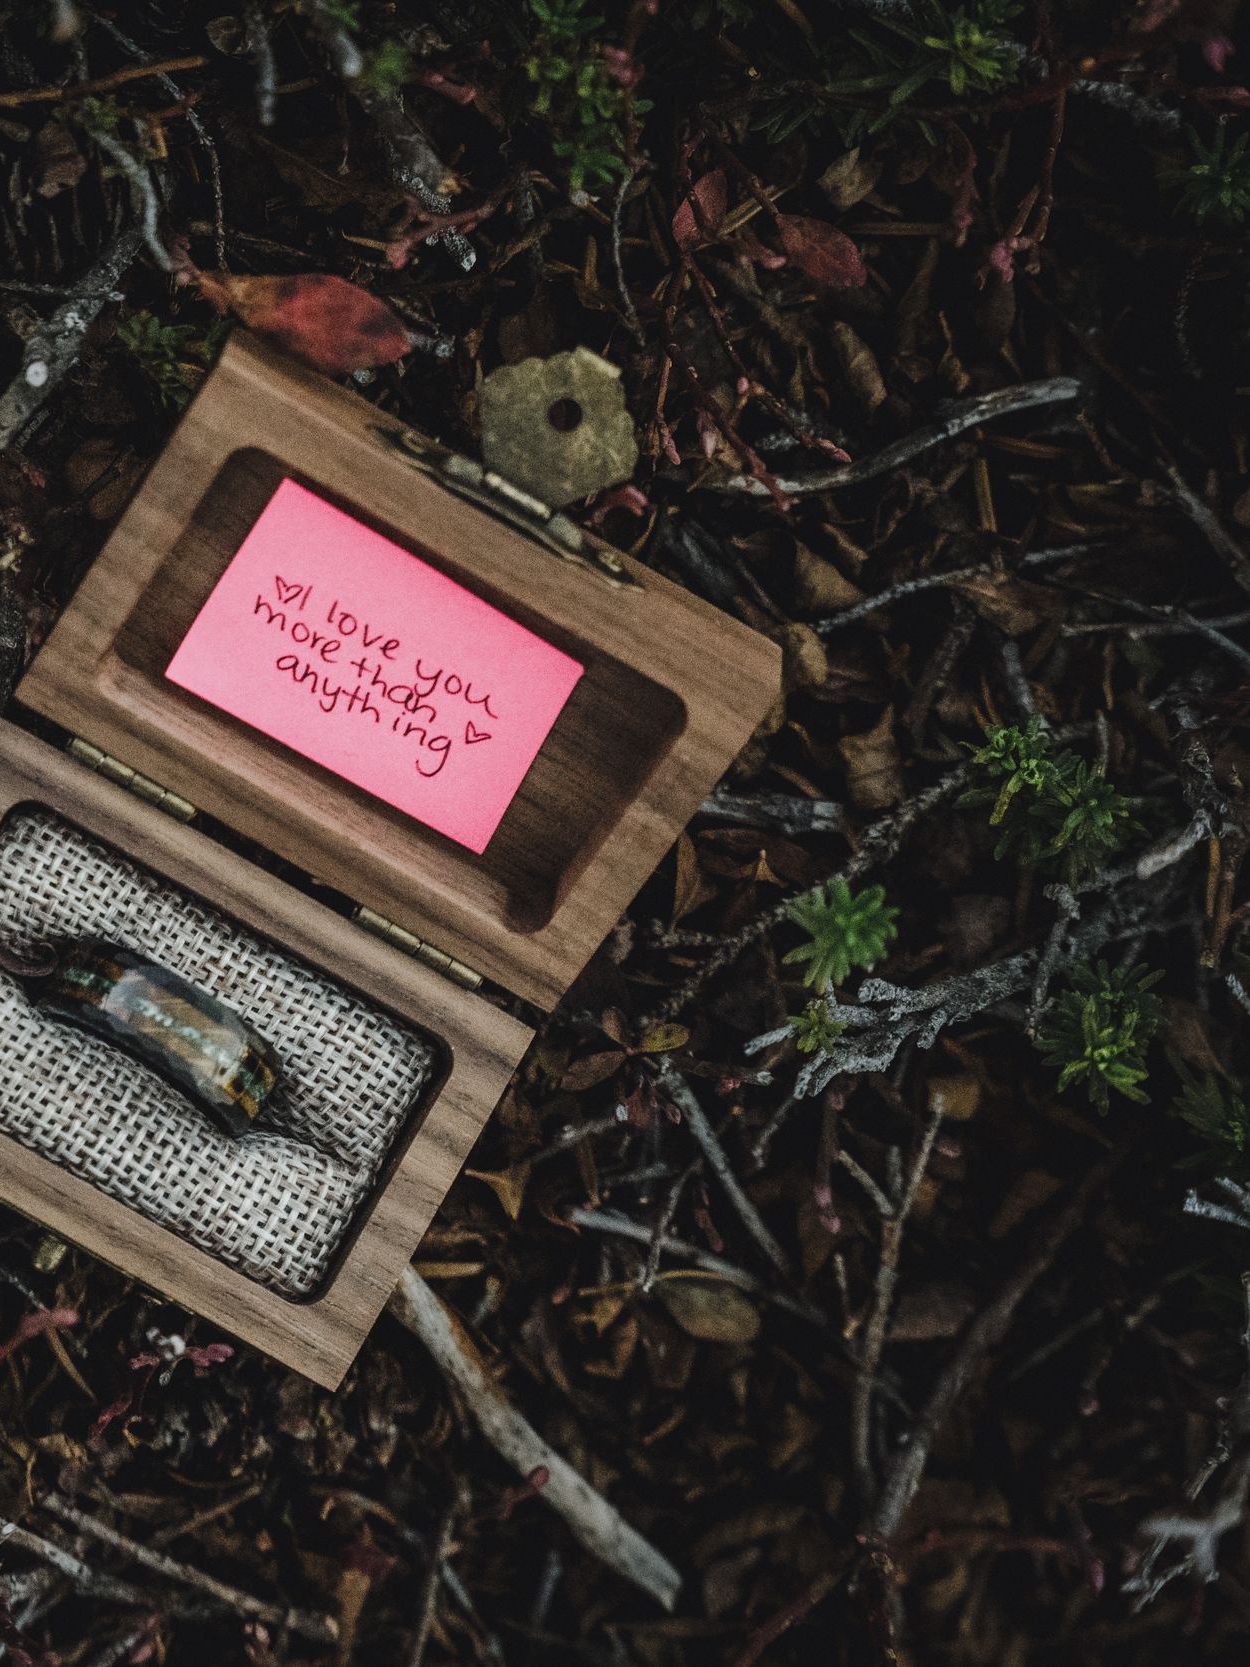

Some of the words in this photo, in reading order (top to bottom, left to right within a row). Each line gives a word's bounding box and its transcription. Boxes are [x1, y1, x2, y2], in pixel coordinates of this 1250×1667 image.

[254, 595, 342, 663] more
[350, 657, 437, 723] than
[276, 654, 452, 777] anything
[326, 600, 400, 660] love
[413, 659, 498, 719] you
